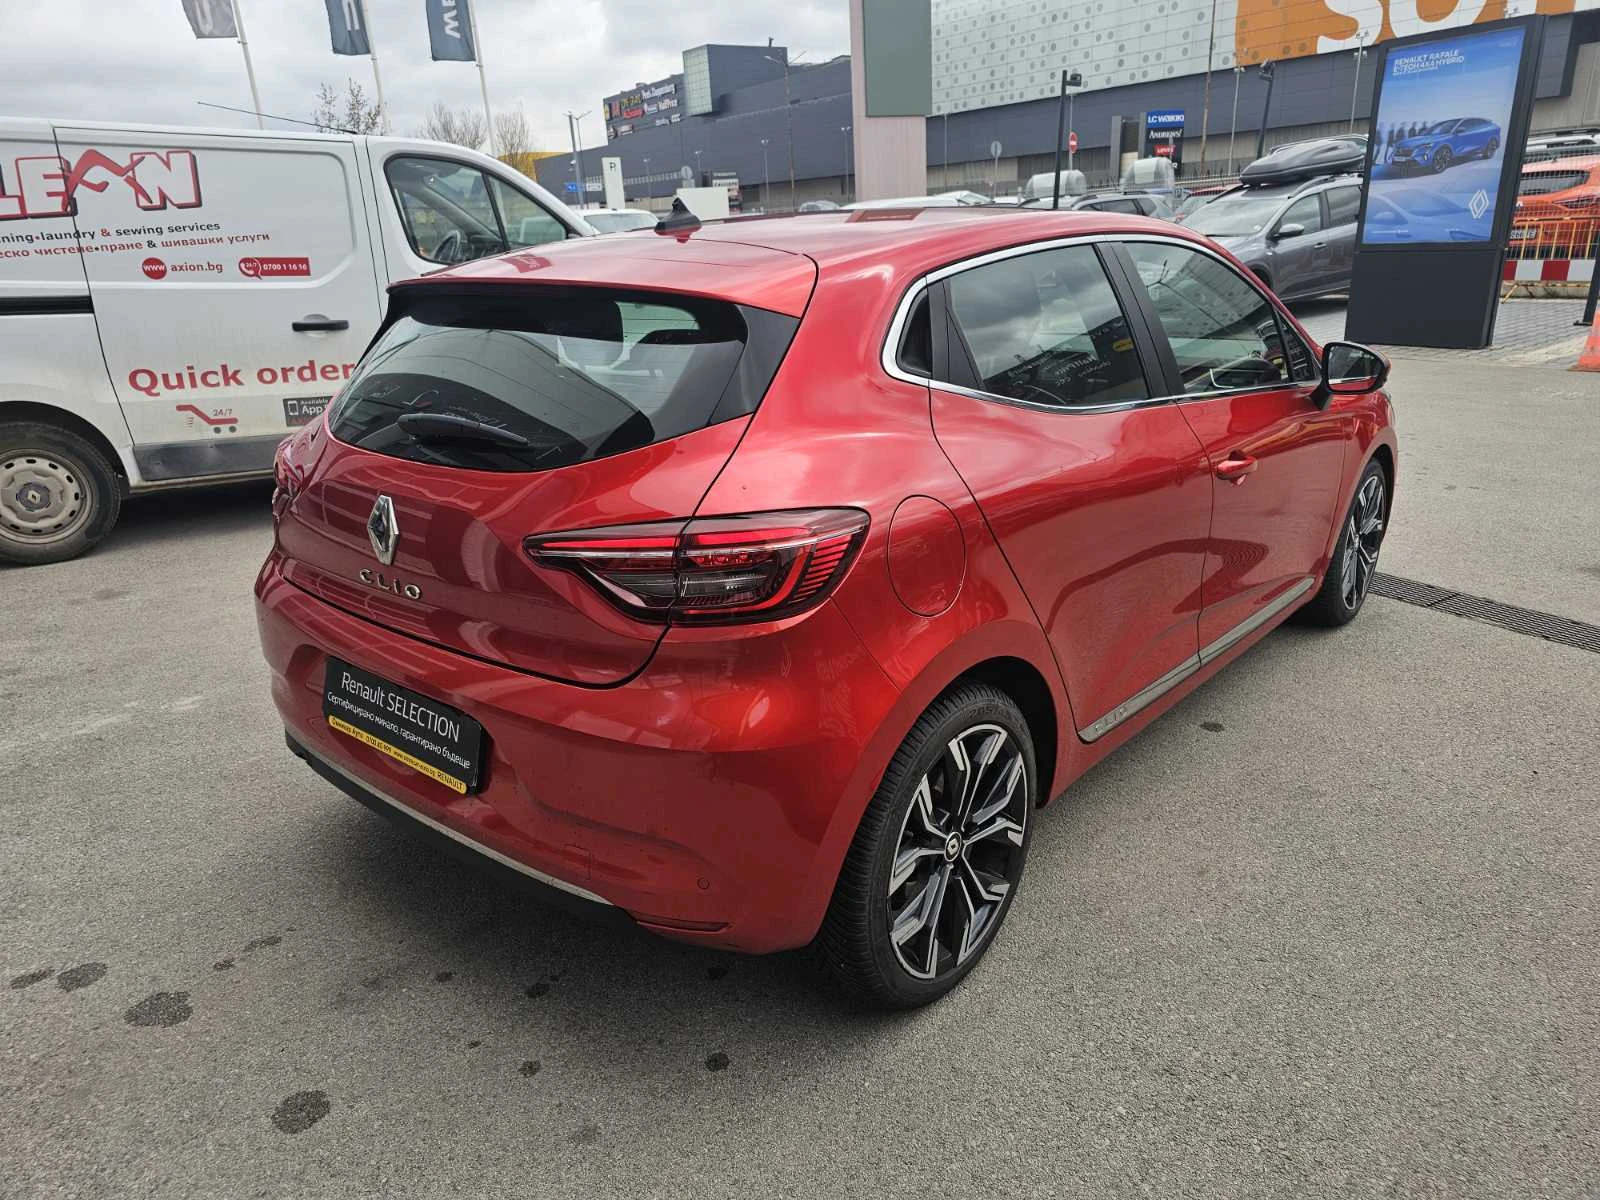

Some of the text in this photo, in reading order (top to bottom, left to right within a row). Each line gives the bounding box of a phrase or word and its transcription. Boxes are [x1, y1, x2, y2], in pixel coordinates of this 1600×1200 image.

[115, 225, 164, 237] sewing
[167, 222, 221, 233] services
[161, 235, 224, 248] шивашки
[227, 233, 271, 245] услуги
[171, 261, 223, 274] axion.bg
[128, 359, 356, 397] Quick order
[359, 568, 422, 600] CLIO
[341, 671, 460, 743] Renault SELECTION
